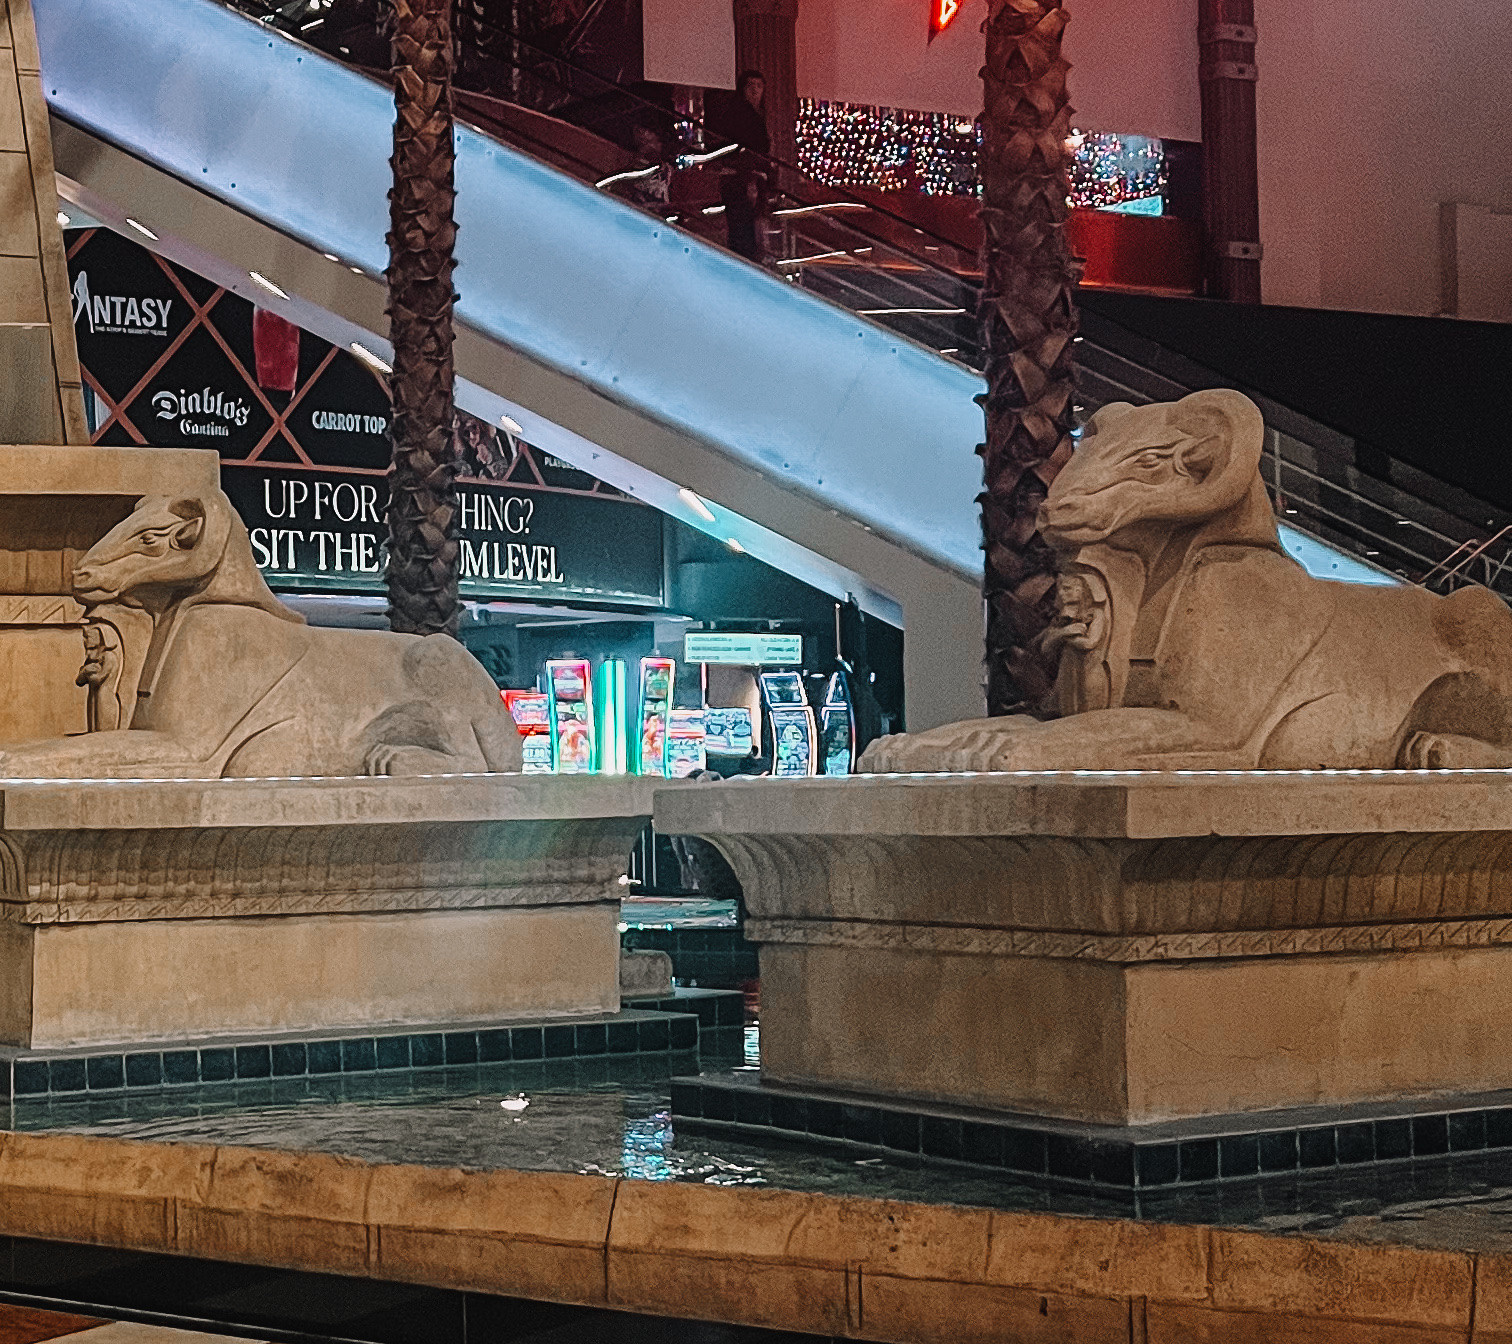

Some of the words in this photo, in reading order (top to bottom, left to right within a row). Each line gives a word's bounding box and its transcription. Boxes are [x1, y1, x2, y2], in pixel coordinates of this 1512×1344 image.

[72, 270, 172, 333] ANTASY
[151, 386, 251, 426] Diablo's
[311, 410, 361, 433] CARROT
[364, 415, 387, 435] TOP
[263, 478, 308, 518] UP
[314, 481, 380, 523] FOR
[246, 527, 304, 569] SIT
[309, 530, 379, 573] THE
[493, 542, 564, 583] LEVEL
